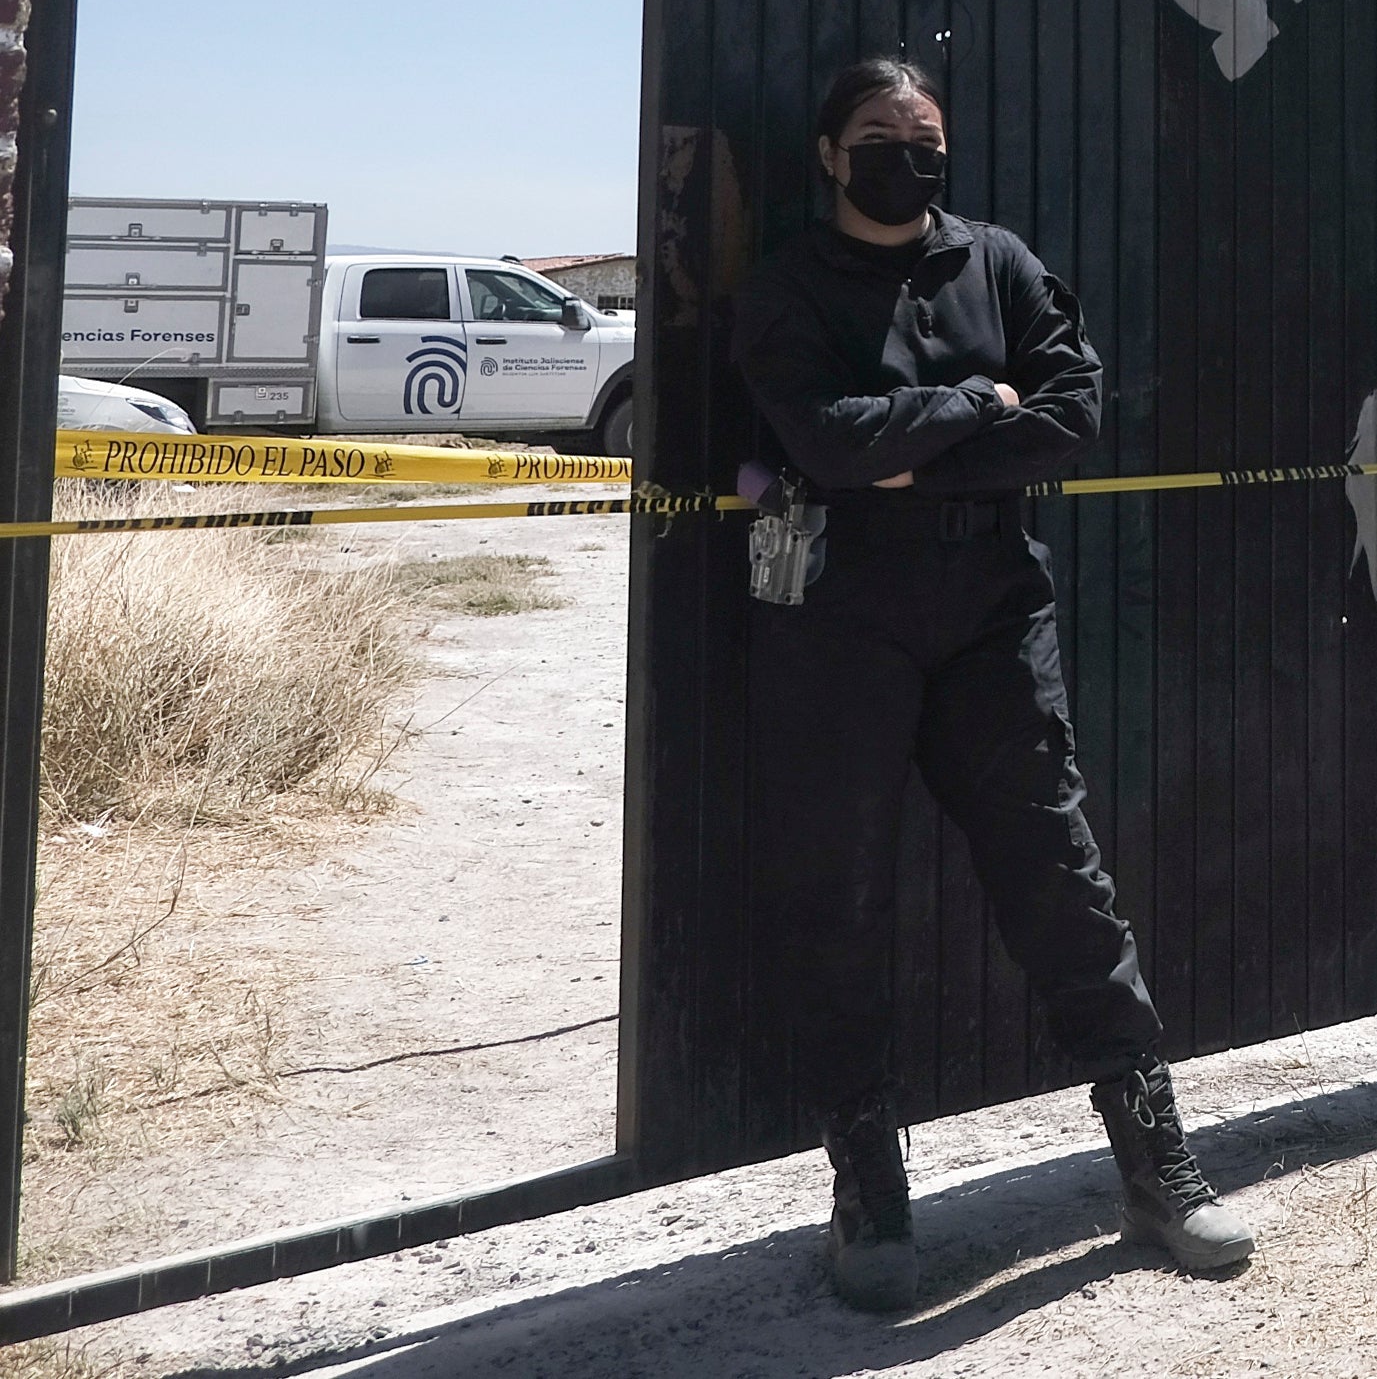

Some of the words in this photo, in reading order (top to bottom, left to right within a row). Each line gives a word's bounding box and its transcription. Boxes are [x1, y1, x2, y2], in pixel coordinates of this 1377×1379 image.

[61, 328, 125, 342] encias
[131, 329, 215, 342] Forenses
[269, 392, 289, 400] 235
[103, 440, 256, 476] PROHIBIDO
[260, 446, 294, 477] EL
[299, 447, 364, 478] PASO
